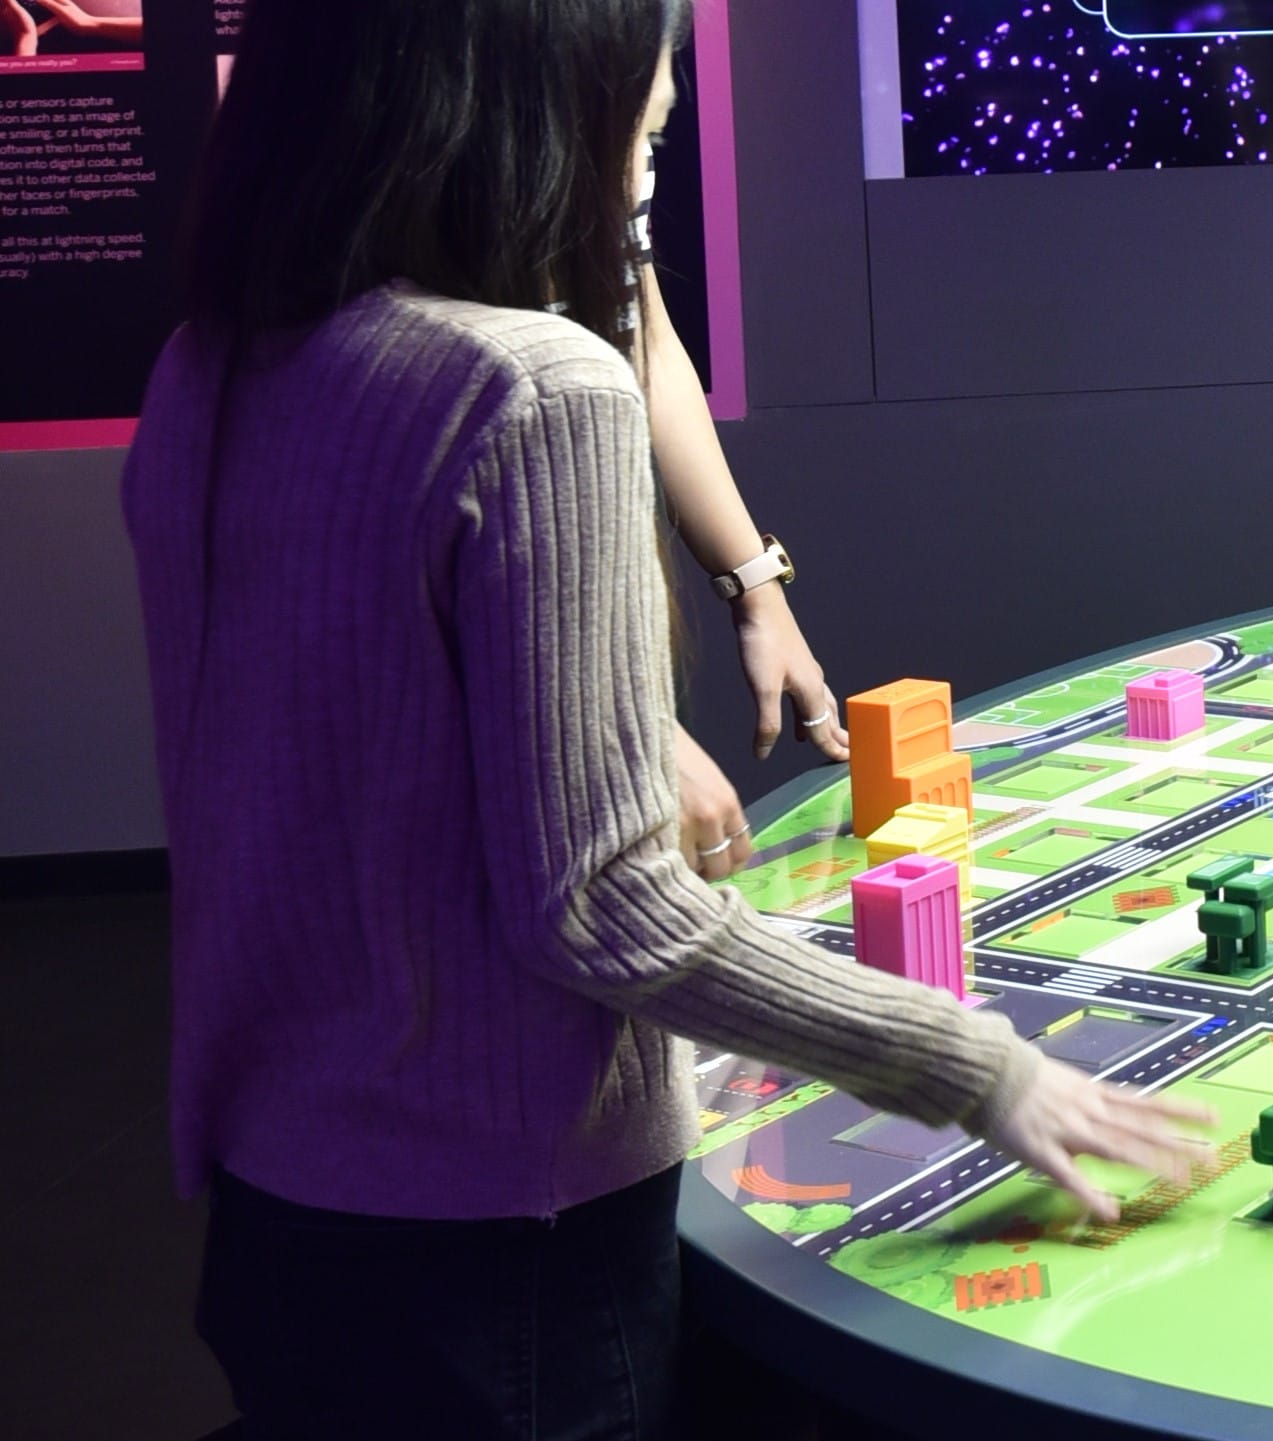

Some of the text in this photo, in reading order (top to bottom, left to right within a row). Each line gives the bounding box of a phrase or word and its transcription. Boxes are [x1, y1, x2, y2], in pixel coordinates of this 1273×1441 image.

[21, 97, 66, 108] sensors
[69, 95, 114, 109] capture
[21, 112, 50, 123] such
[52, 114, 66, 123] as
[68, 113, 83, 122] an
[85, 111, 121, 124] image
[45, 143, 73, 154] then
[74, 143, 105, 153] turns
[107, 141, 131, 152] that
[50, 158, 85, 171] digital
[121, 156, 143, 167] and
[40, 175, 71, 185] other
[74, 173, 100, 183] data
[103, 171, 156, 183] collected
[20, 190, 52, 200] faces
